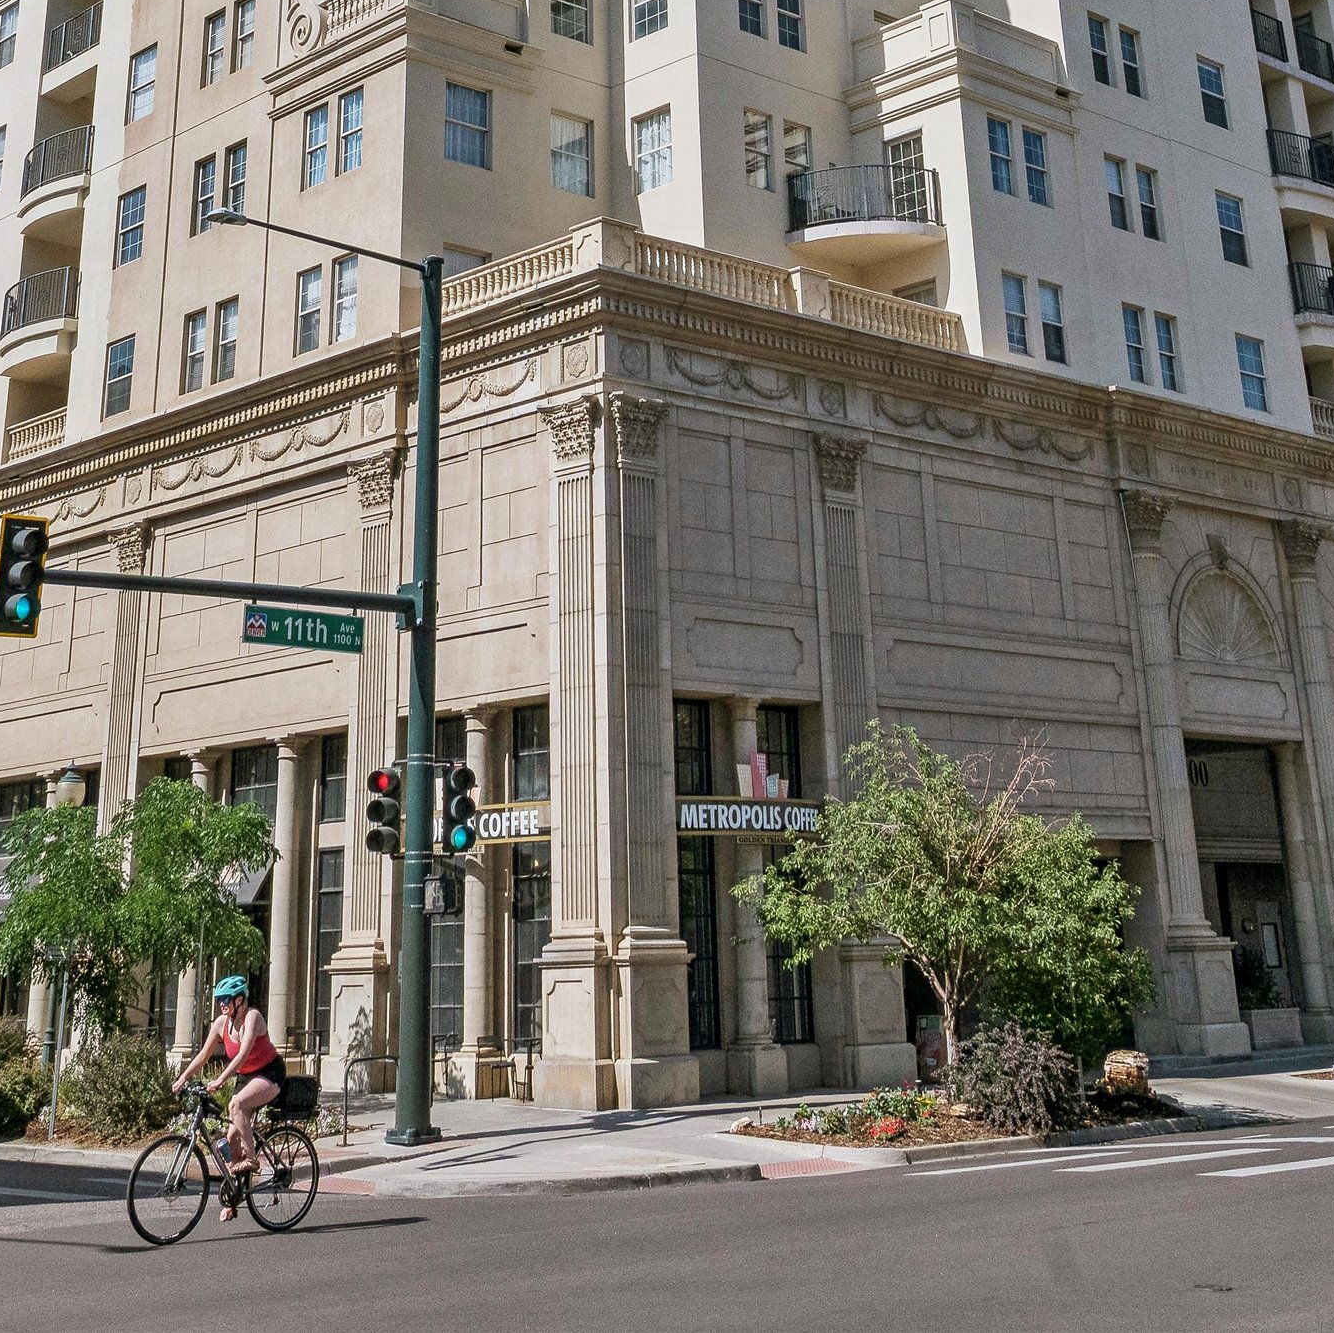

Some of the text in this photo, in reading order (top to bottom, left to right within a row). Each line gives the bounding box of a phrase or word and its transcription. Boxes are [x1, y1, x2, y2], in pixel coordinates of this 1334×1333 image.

[271, 616, 355, 644] W 11th Ave
[333, 633, 361, 646] 1100 N
[479, 810, 539, 838] COFFEE
[680, 803, 782, 831] METROPOLIS
